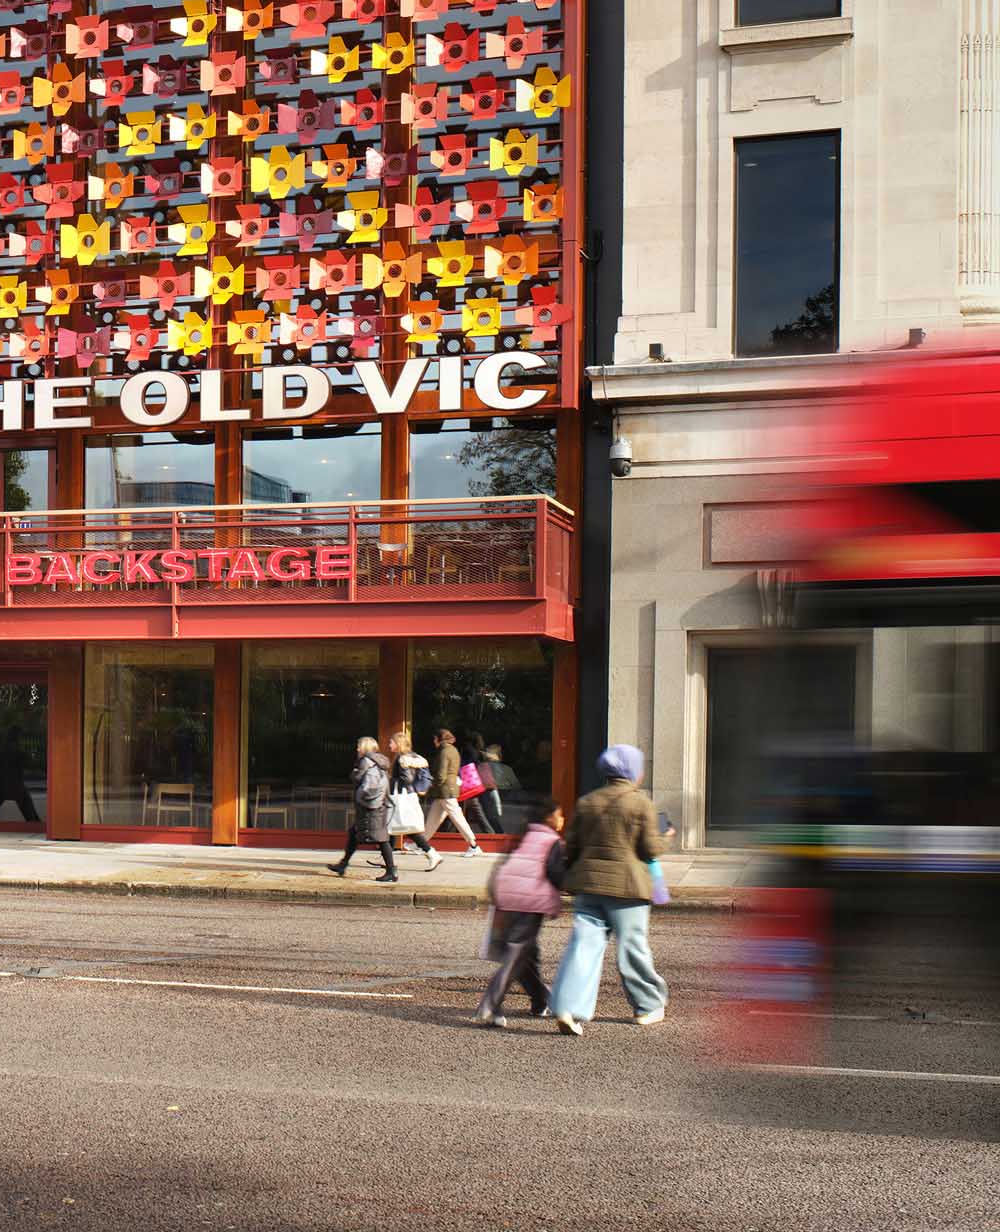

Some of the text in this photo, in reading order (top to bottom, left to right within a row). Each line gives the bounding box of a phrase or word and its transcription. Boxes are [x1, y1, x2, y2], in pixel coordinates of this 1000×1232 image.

[119, 365, 331, 427] OLD
[353, 350, 550, 415] VIC
[7, 545, 353, 585] BACKSTAGE
